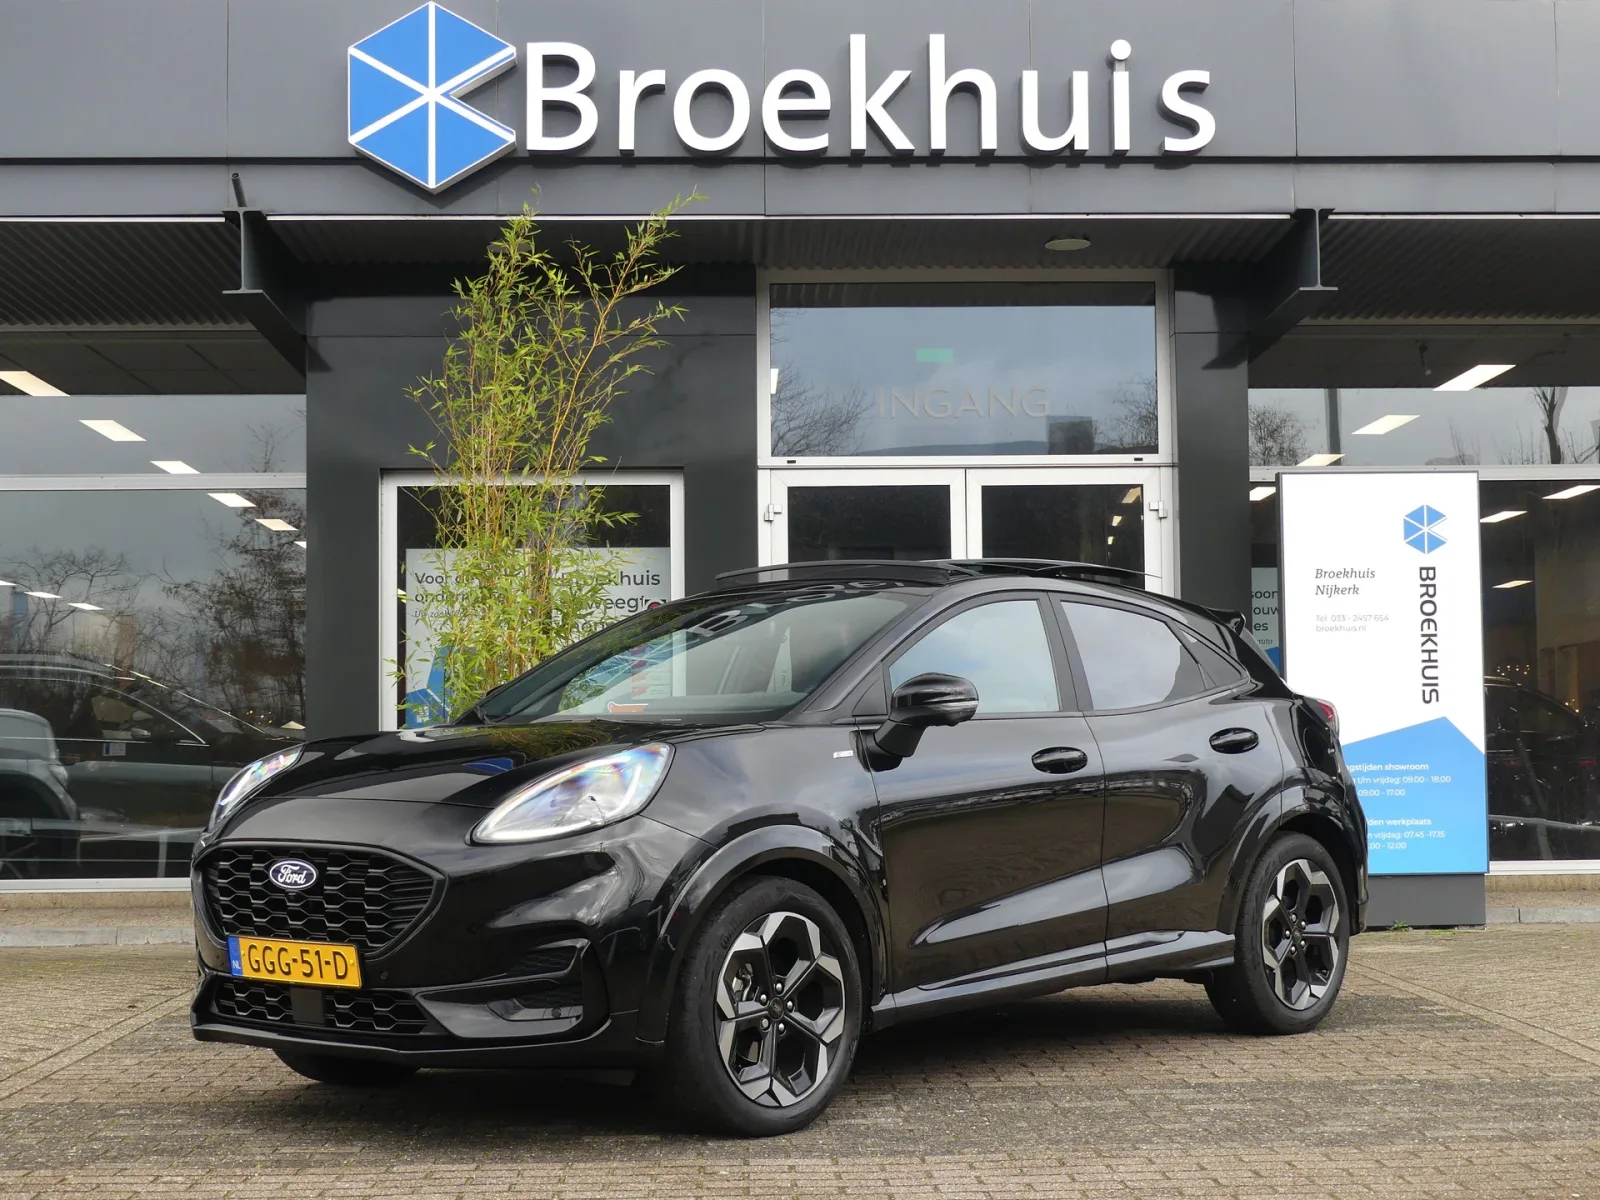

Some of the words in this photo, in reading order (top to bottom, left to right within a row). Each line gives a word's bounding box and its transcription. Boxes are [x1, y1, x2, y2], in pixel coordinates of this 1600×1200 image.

[525, 33, 1217, 155] Broekhuis
[877, 386, 1051, 419] INGANG
[1314, 567, 1376, 579] Broekhuis
[1314, 584, 1360, 599] Nijkerk
[1330, 614, 1346, 622] 033
[1315, 624, 1367, 632] broekhuis.nl
[1418, 566, 1439, 705] BROEKHUIS
[1384, 762, 1429, 772] showroom
[1386, 817, 1432, 828] werkplaats
[278, 863, 307, 885] Ford
[232, 959, 242, 970] NL
[247, 943, 349, 981] GGG-51-D
